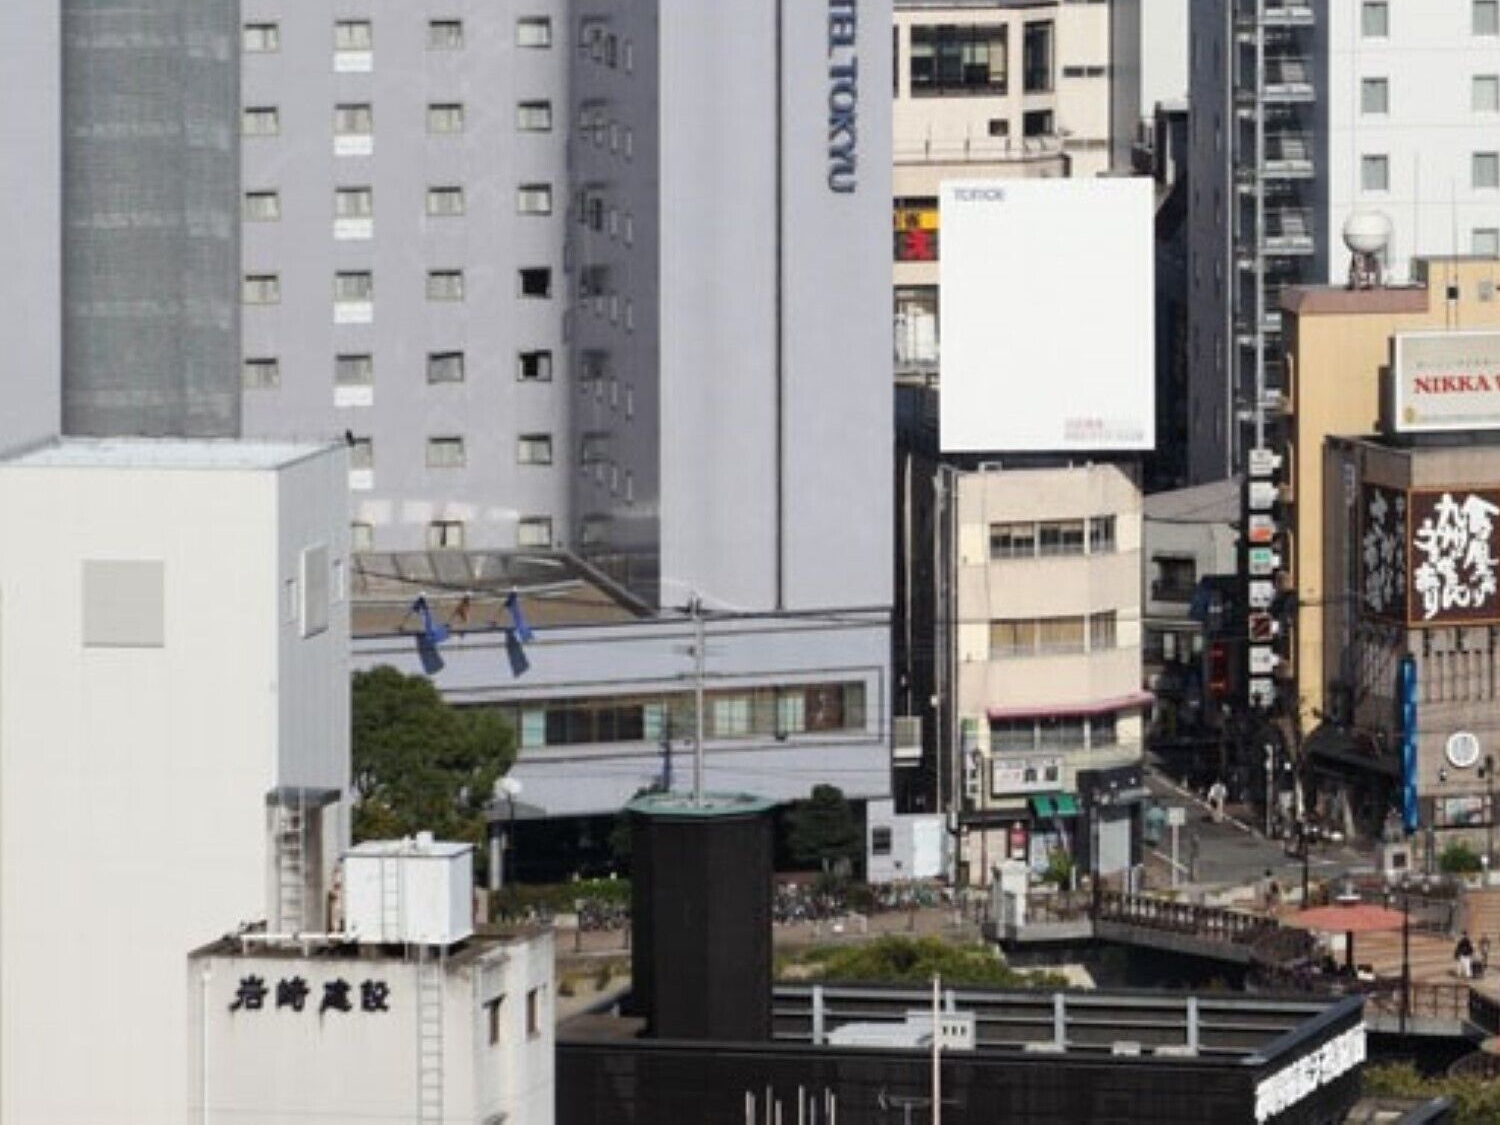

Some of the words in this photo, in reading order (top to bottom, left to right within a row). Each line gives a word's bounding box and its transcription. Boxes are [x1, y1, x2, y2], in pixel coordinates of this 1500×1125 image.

[829, 56, 857, 194] TOKYU
[1413, 373, 1491, 394] NIKKA
[228, 974, 390, 1013] 岩崎建設
